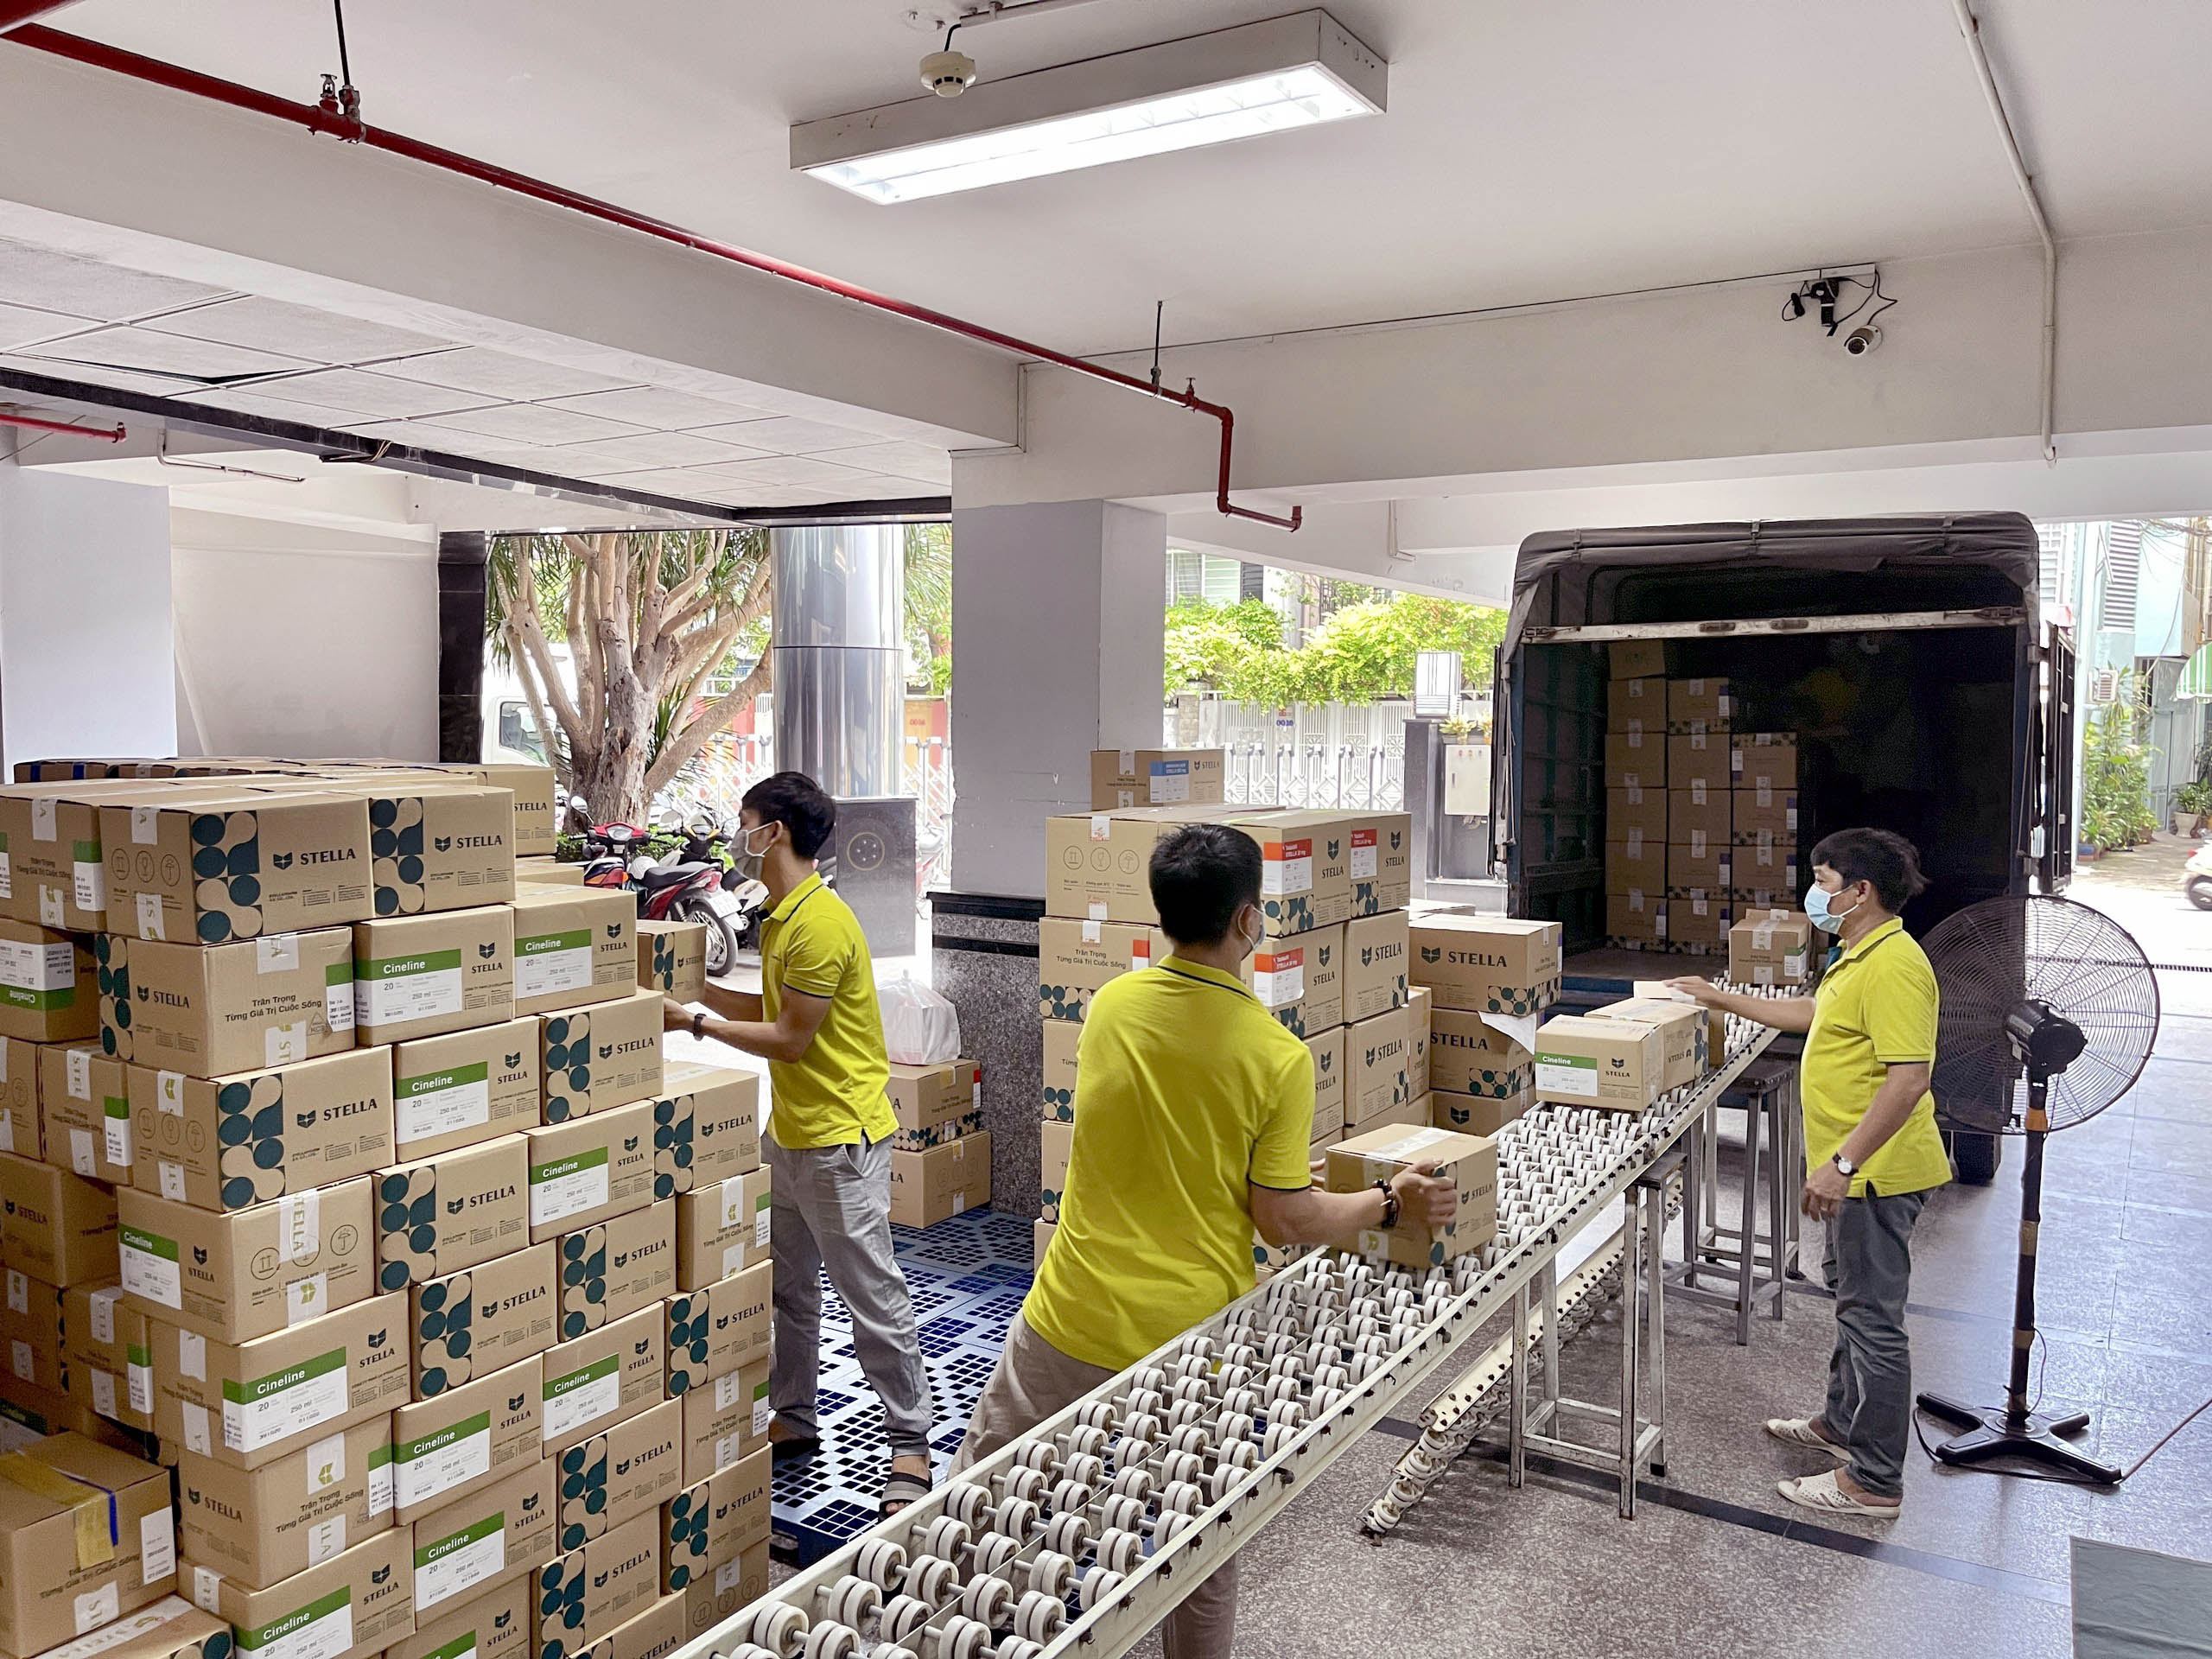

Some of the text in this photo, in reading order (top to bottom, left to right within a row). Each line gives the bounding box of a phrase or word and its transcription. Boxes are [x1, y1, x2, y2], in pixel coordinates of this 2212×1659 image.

[514, 802, 547, 811] STELLA
[456, 835, 502, 849] STELLA
[301, 849, 357, 866] STELLA
[1385, 855, 1405, 868] STELLA
[1321, 866, 1344, 879] STELLA
[525, 938, 561, 951] Cineline
[601, 942, 627, 951] STELLA
[1375, 942, 1402, 962] STELLA
[383, 960, 426, 975] Cineline
[471, 962, 503, 974] STELLA
[1448, 951, 1507, 968] STELLA
[1313, 970, 1335, 987] STELLA
[154, 990, 189, 1008] STELLA
[251, 994, 296, 1007] Trân Trọng
[225, 998, 322, 1023] Từng Giá Trị Cuộc Sống
[616, 1036, 655, 1054] STELLA
[1377, 1039, 1402, 1061] STELLA
[1430, 1033, 1489, 1051] STELLA
[1542, 1055, 1572, 1065] Cineline
[411, 1075, 454, 1092] Cineline
[497, 1071, 528, 1084] STELLA
[1315, 1075, 1336, 1093] STELLA
[323, 1097, 378, 1122] STELLA
[412, 1098, 423, 1108] 20
[717, 1114, 753, 1133] STELLA
[617, 1153, 644, 1167] STELLA
[542, 1161, 578, 1178] Cineline
[469, 1185, 516, 1209] STELLA
[543, 1184, 551, 1192] 20
[1471, 1184, 1493, 1199] STELLA
[294, 1198, 305, 1253] TELLA
[124, 1231, 153, 1250] Cineline
[631, 1239, 668, 1262] STELLA
[188, 1267, 215, 1283] STELLA
[502, 1285, 546, 1311] STELLA
[731, 1302, 765, 1324] STELLA
[359, 1347, 396, 1369] STELLA
[628, 1354, 655, 1371] STELLA
[257, 1369, 306, 1395] Cineline
[554, 1372, 590, 1393] Cineline
[258, 1402, 270, 1412] 20
[290, 1399, 313, 1414] 250 ml
[555, 1398, 563, 1408] 20
[499, 1409, 531, 1430] STELLA
[413, 1430, 455, 1455] Cineline
[633, 1440, 673, 1467] STELLA
[414, 1459, 424, 1471] 20
[300, 1490, 341, 1512] Trân Trọng
[730, 1486, 764, 1512] STELLA
[204, 1496, 243, 1523] STELLA
[276, 1519, 297, 1534] Từng
[298, 1511, 312, 1522] Giá
[313, 1507, 324, 1517] Trị
[324, 1497, 345, 1512] Cuộc
[345, 1488, 365, 1502] Sống
[514, 1509, 545, 1529] STELLA
[428, 1533, 470, 1559] Cineline
[429, 1564, 438, 1575] 20
[612, 1548, 651, 1579] STELLA
[364, 1580, 399, 1605] STELLA
[263, 1611, 310, 1641] Cineline
[486, 1625, 518, 1648] STELLA
[264, 1646, 276, 1657] 20
